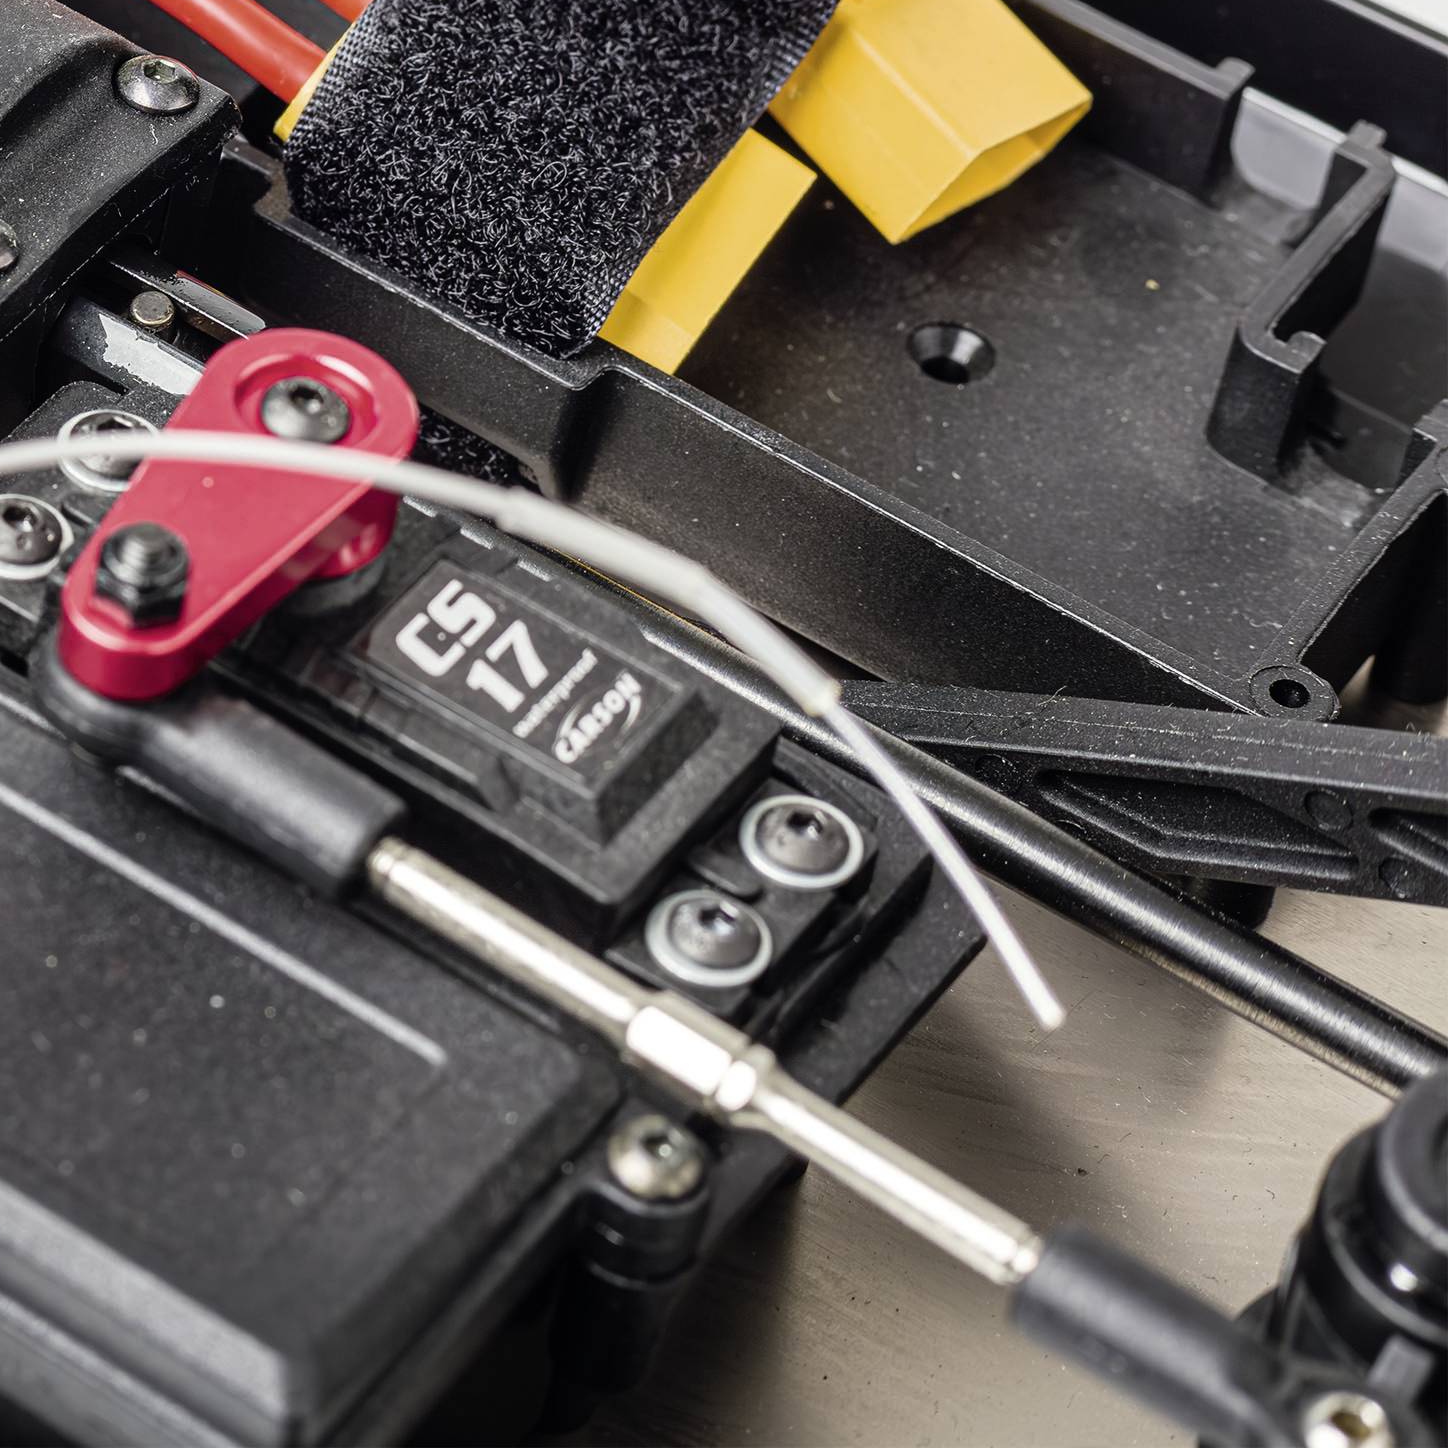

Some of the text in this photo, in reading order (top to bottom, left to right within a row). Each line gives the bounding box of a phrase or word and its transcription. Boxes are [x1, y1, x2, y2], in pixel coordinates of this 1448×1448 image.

[395, 578, 497, 678] CS
[465, 618, 550, 714] 17
[555, 669, 642, 764] CARSON
